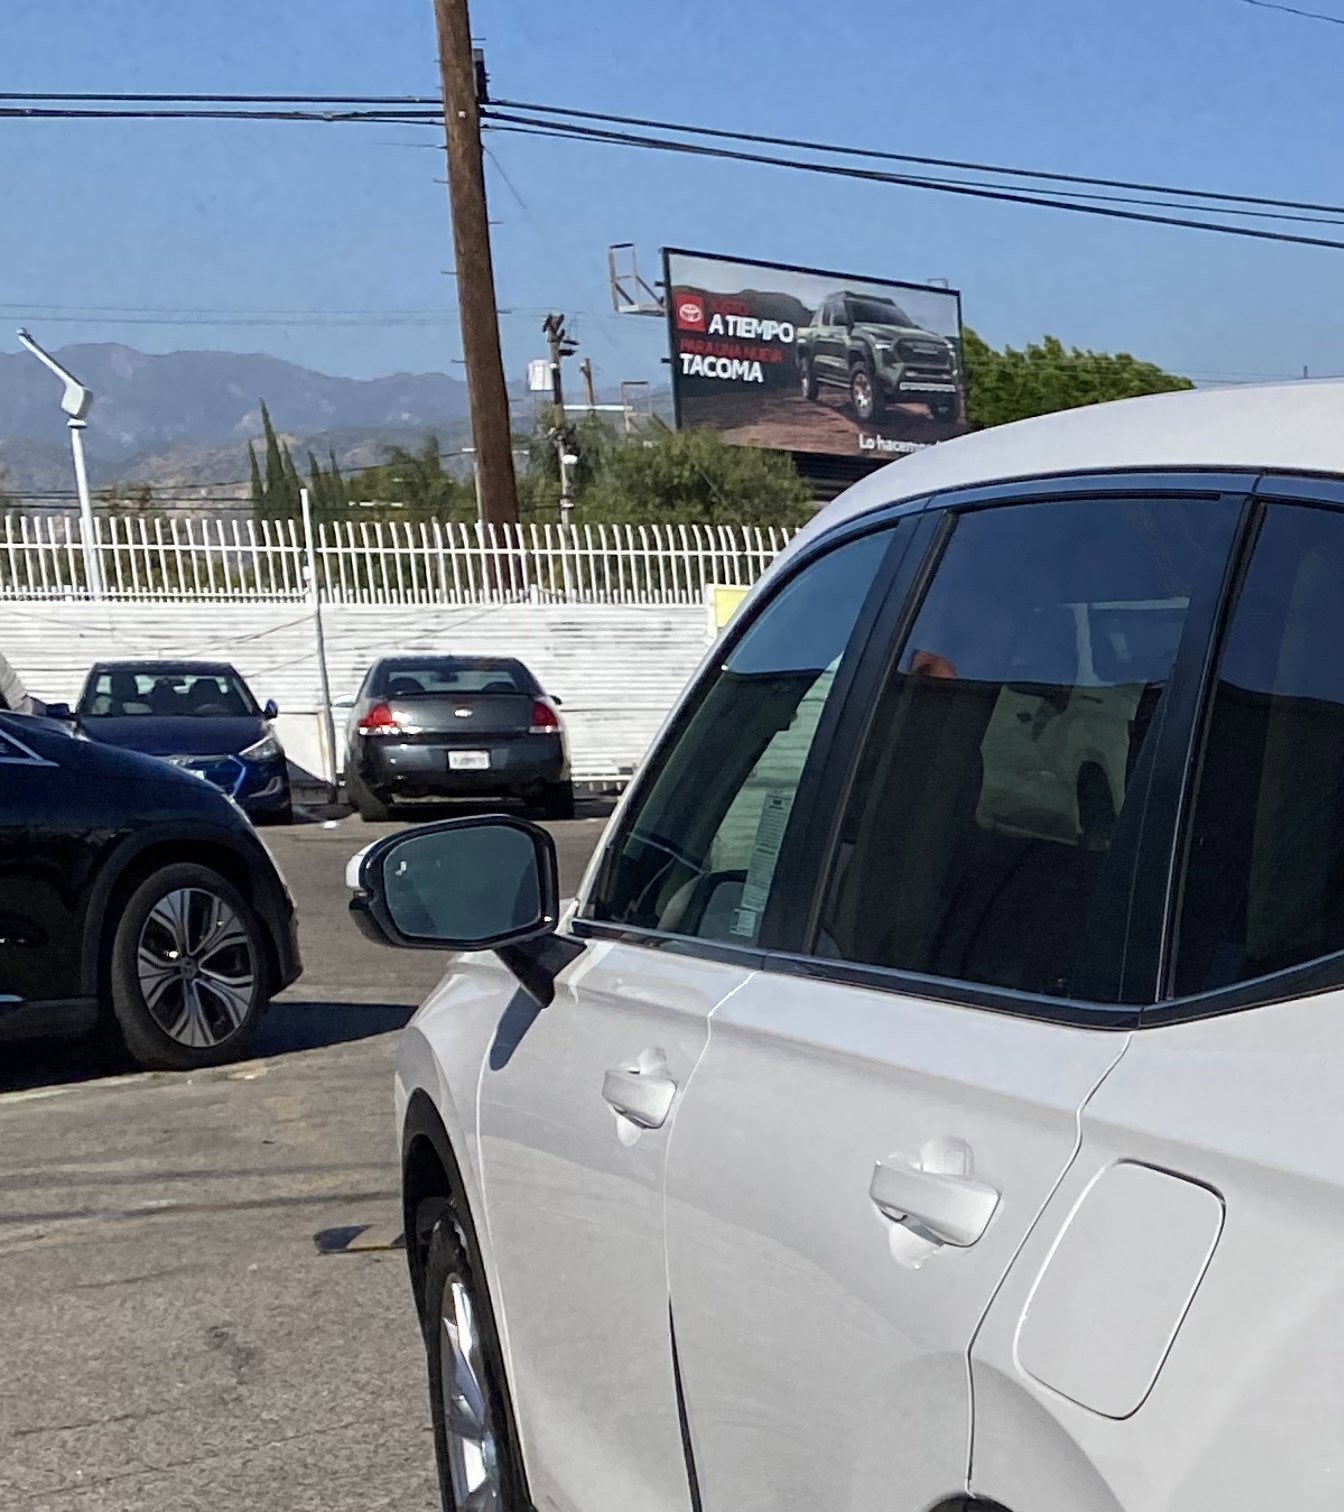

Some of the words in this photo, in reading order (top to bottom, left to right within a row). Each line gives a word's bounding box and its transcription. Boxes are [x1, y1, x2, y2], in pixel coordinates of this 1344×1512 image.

[708, 313, 724, 335] A
[725, 315, 794, 343] TIEMPO
[680, 353, 763, 382] TACOMA
